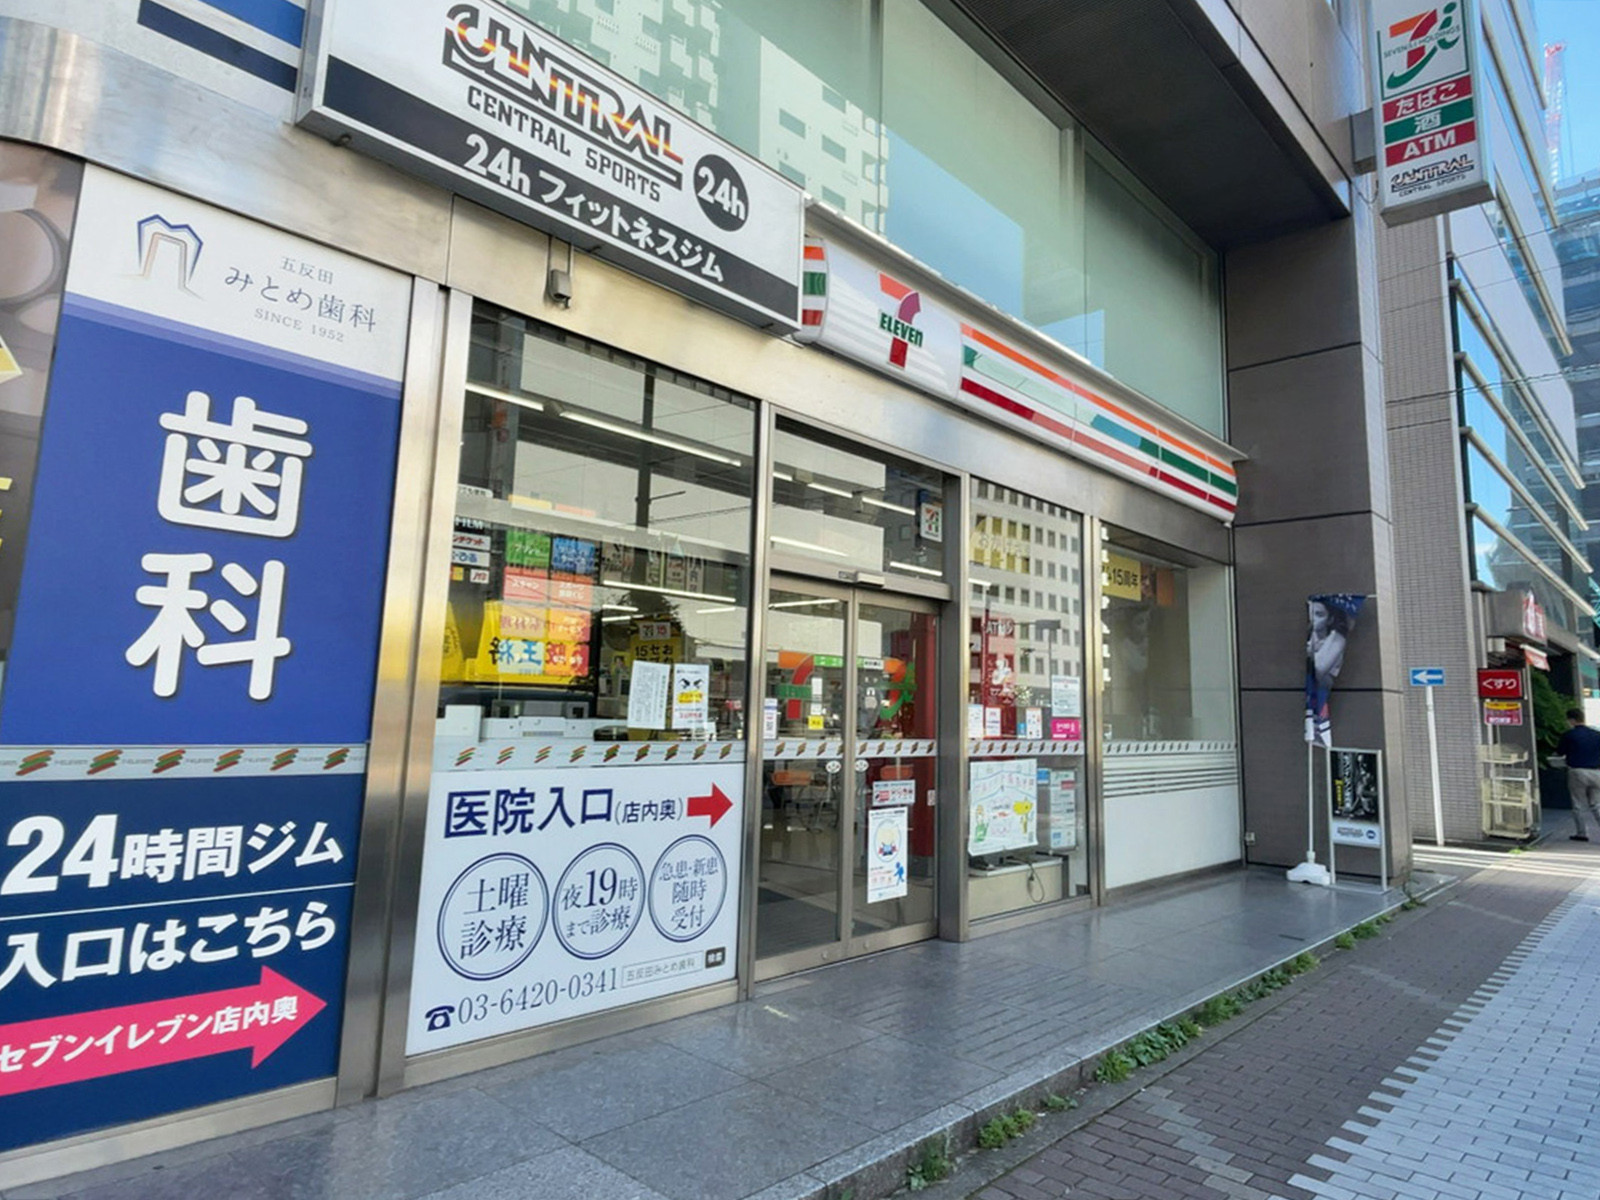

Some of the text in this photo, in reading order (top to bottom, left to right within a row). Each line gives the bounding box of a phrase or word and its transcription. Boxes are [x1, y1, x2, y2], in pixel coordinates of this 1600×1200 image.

[441, 3, 683, 190] CENTRAL
[1396, 83, 1459, 117] たばこ
[467, 85, 661, 202] CENTRAL SPORTS
[1414, 109, 1441, 133] 酒
[1403, 129, 1456, 160] ATM
[697, 166, 747, 221] 24h
[280, 257, 334, 285] 五反田
[224, 266, 377, 333] みとめ歯科
[254, 308, 345, 343] SINCE 1952
[124, 390, 313, 701] 歯科
[0, 814, 344, 895] 24時間ジム
[463, 872, 530, 916] 土曜
[561, 867, 639, 911] 夜19時
[672, 878, 707, 904] 随時
[460, 914, 527, 960] 診療
[566, 905, 632, 939] まで診療
[671, 904, 705, 932] 受付
[0, 902, 336, 990] 入口はこちら
[458, 968, 618, 1025] 03-6420-0341
[0, 996, 298, 1073] セブンイレブン店内奥
